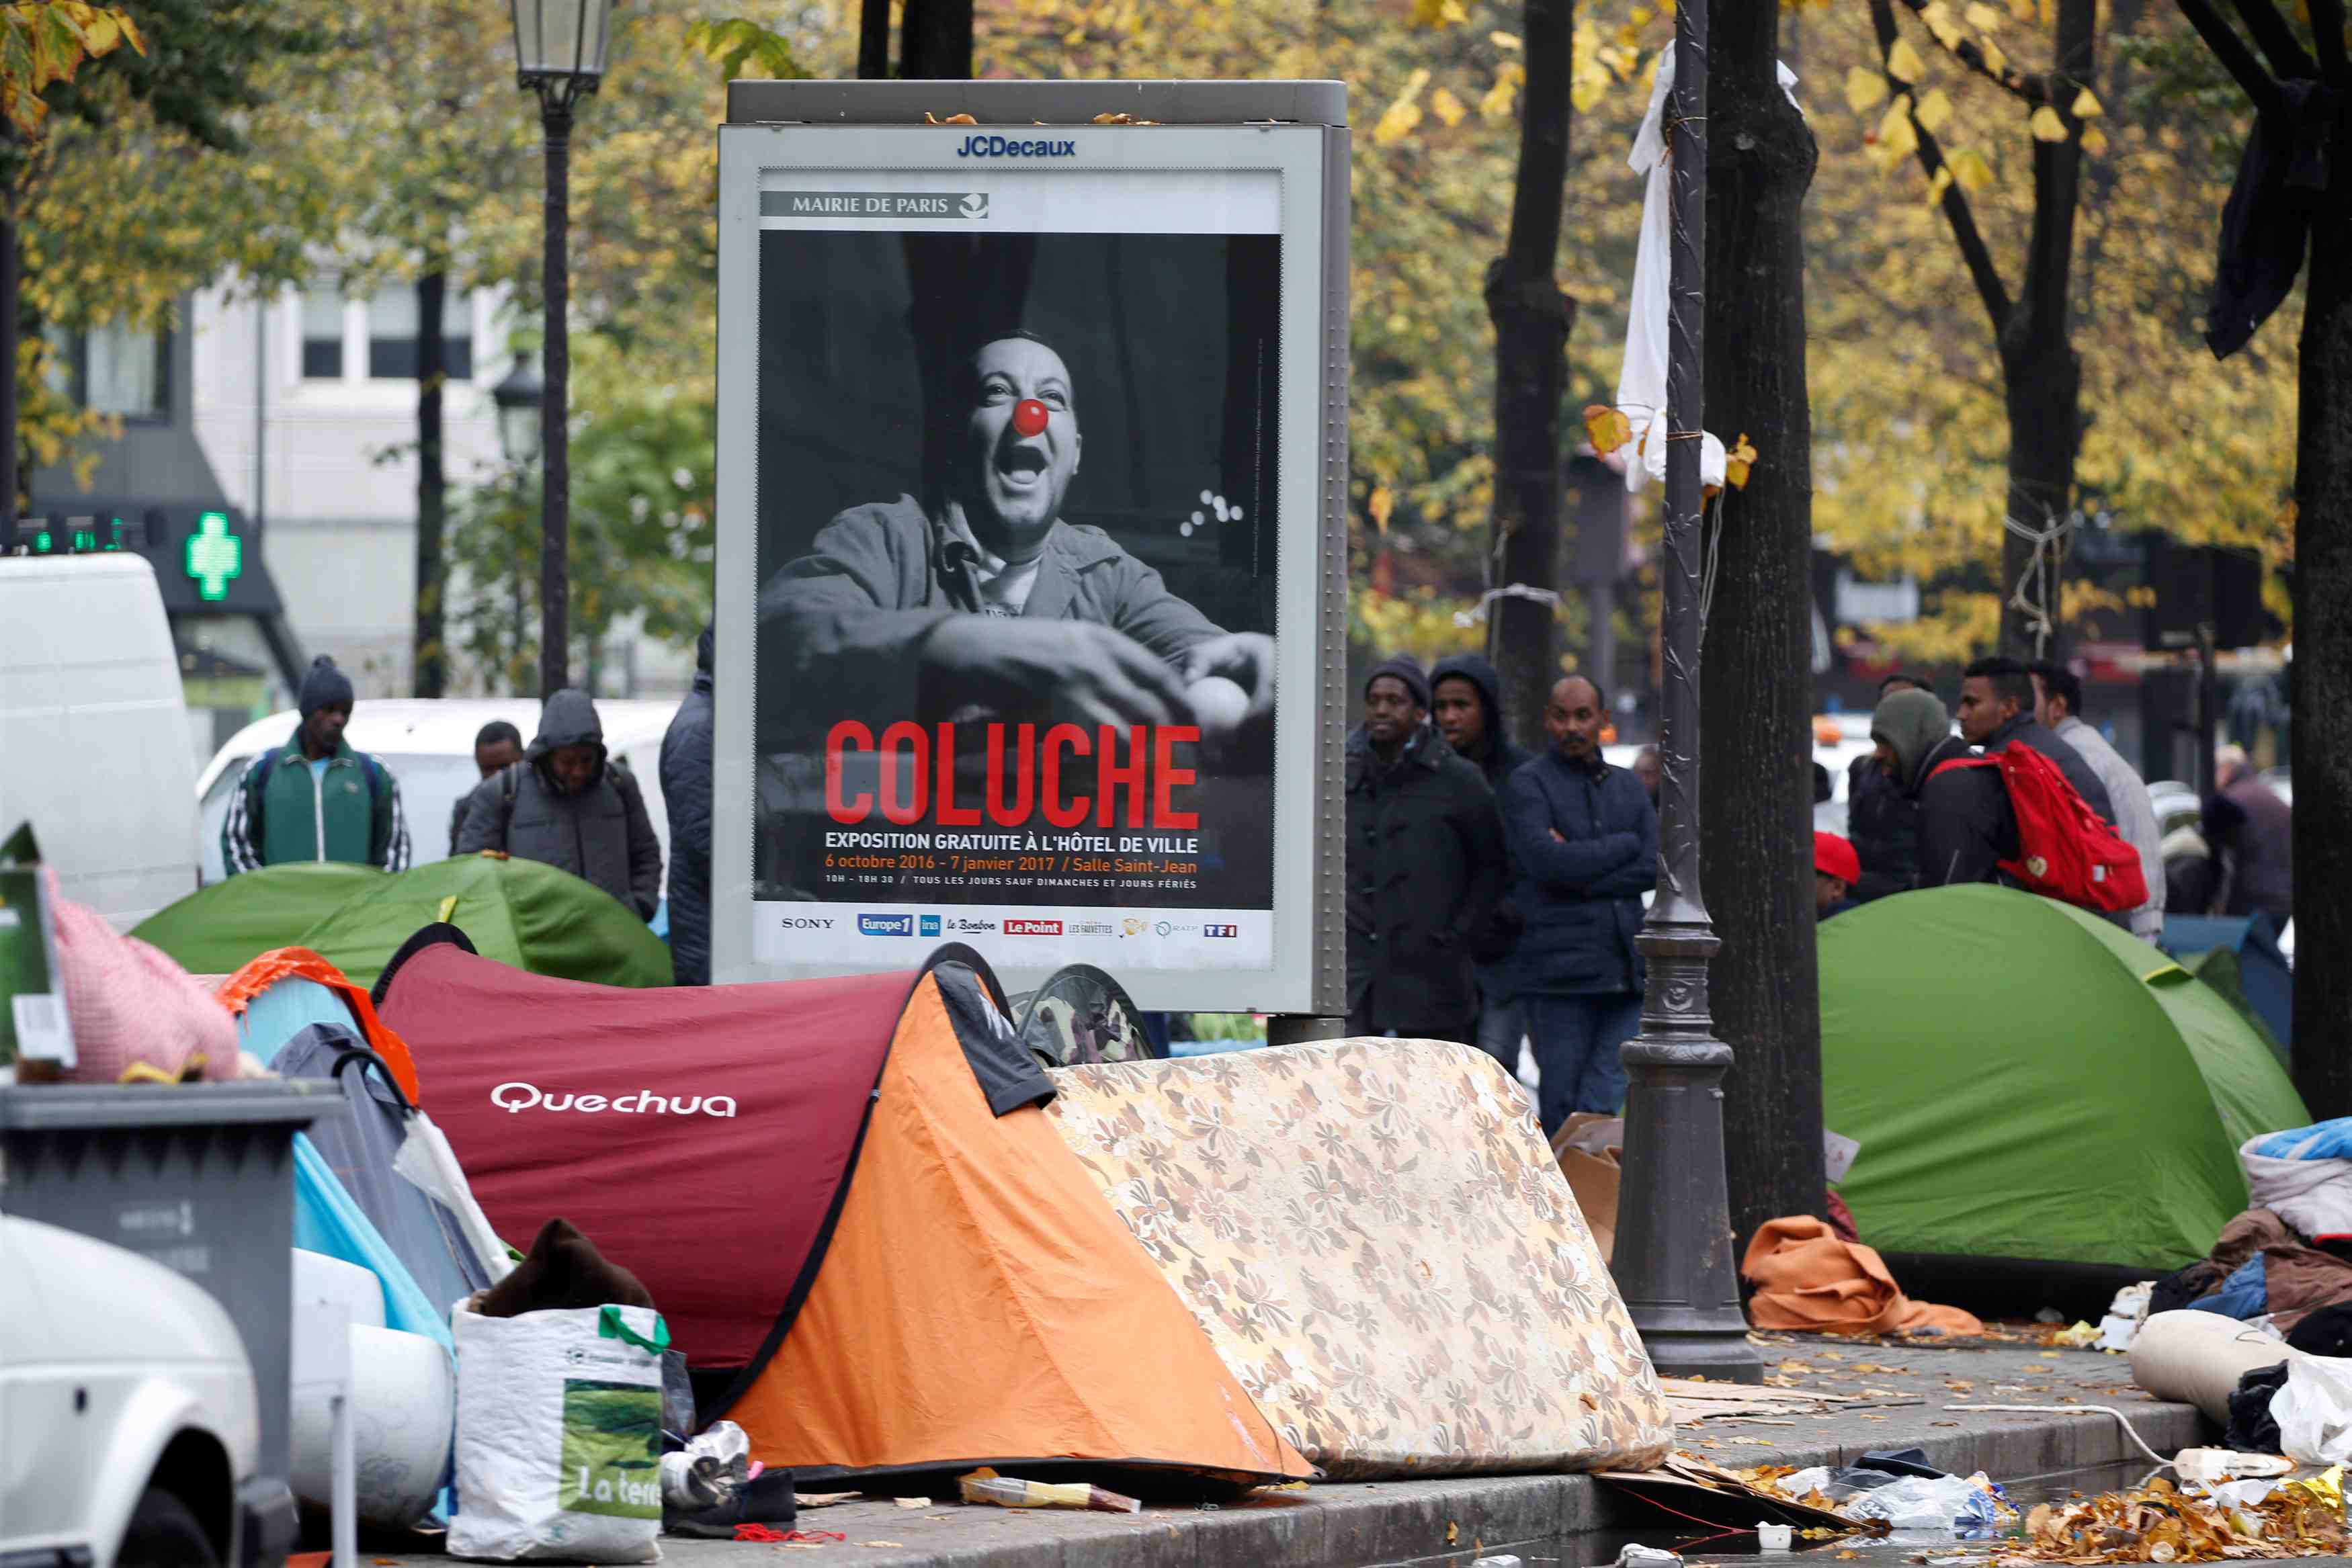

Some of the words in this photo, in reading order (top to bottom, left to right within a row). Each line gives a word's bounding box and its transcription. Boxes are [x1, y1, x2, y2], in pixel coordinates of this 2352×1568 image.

[957, 136, 1075, 156] JCDecaux
[792, 198, 860, 212] MAIRIE
[866, 198, 891, 212] DE
[897, 198, 948, 213] PARIS
[827, 720, 1200, 829] COLUCHE
[825, 832, 930, 849] EXPOSITION
[935, 834, 1021, 851] GRATUITE
[1025, 830, 1038, 851] À
[1042, 832, 1116, 853] L'HÔTEL
[1120, 837, 1142, 853] DE
[1146, 838, 1198, 854] VILLE
[825, 854, 834, 867] 6
[839, 855, 896, 868] octobre
[899, 855, 935, 869] 2016
[950, 856, 960, 869] 7
[962, 856, 1014, 873] janvier
[1018, 857, 1054, 871] 2017
[1073, 857, 1111, 871] Salle
[1114, 858, 1198, 873] Saint-Jean
[826, 875, 845, 883] 10H
[913, 876, 941, 884] TOUS
[945, 877, 964, 885] LES
[968, 877, 1002, 885] JOURS
[1005, 877, 1033, 885] SAUF
[1037, 878, 1099, 887] DIMANCHES
[1103, 879, 1116, 887] ET
[1120, 879, 1154, 888] JOURS
[1158, 879, 1197, 889] FÉRIÉS
[782, 918, 835, 929] SONY
[491, 1082, 737, 1118] Quechua
[581, 1466, 612, 1502] La
